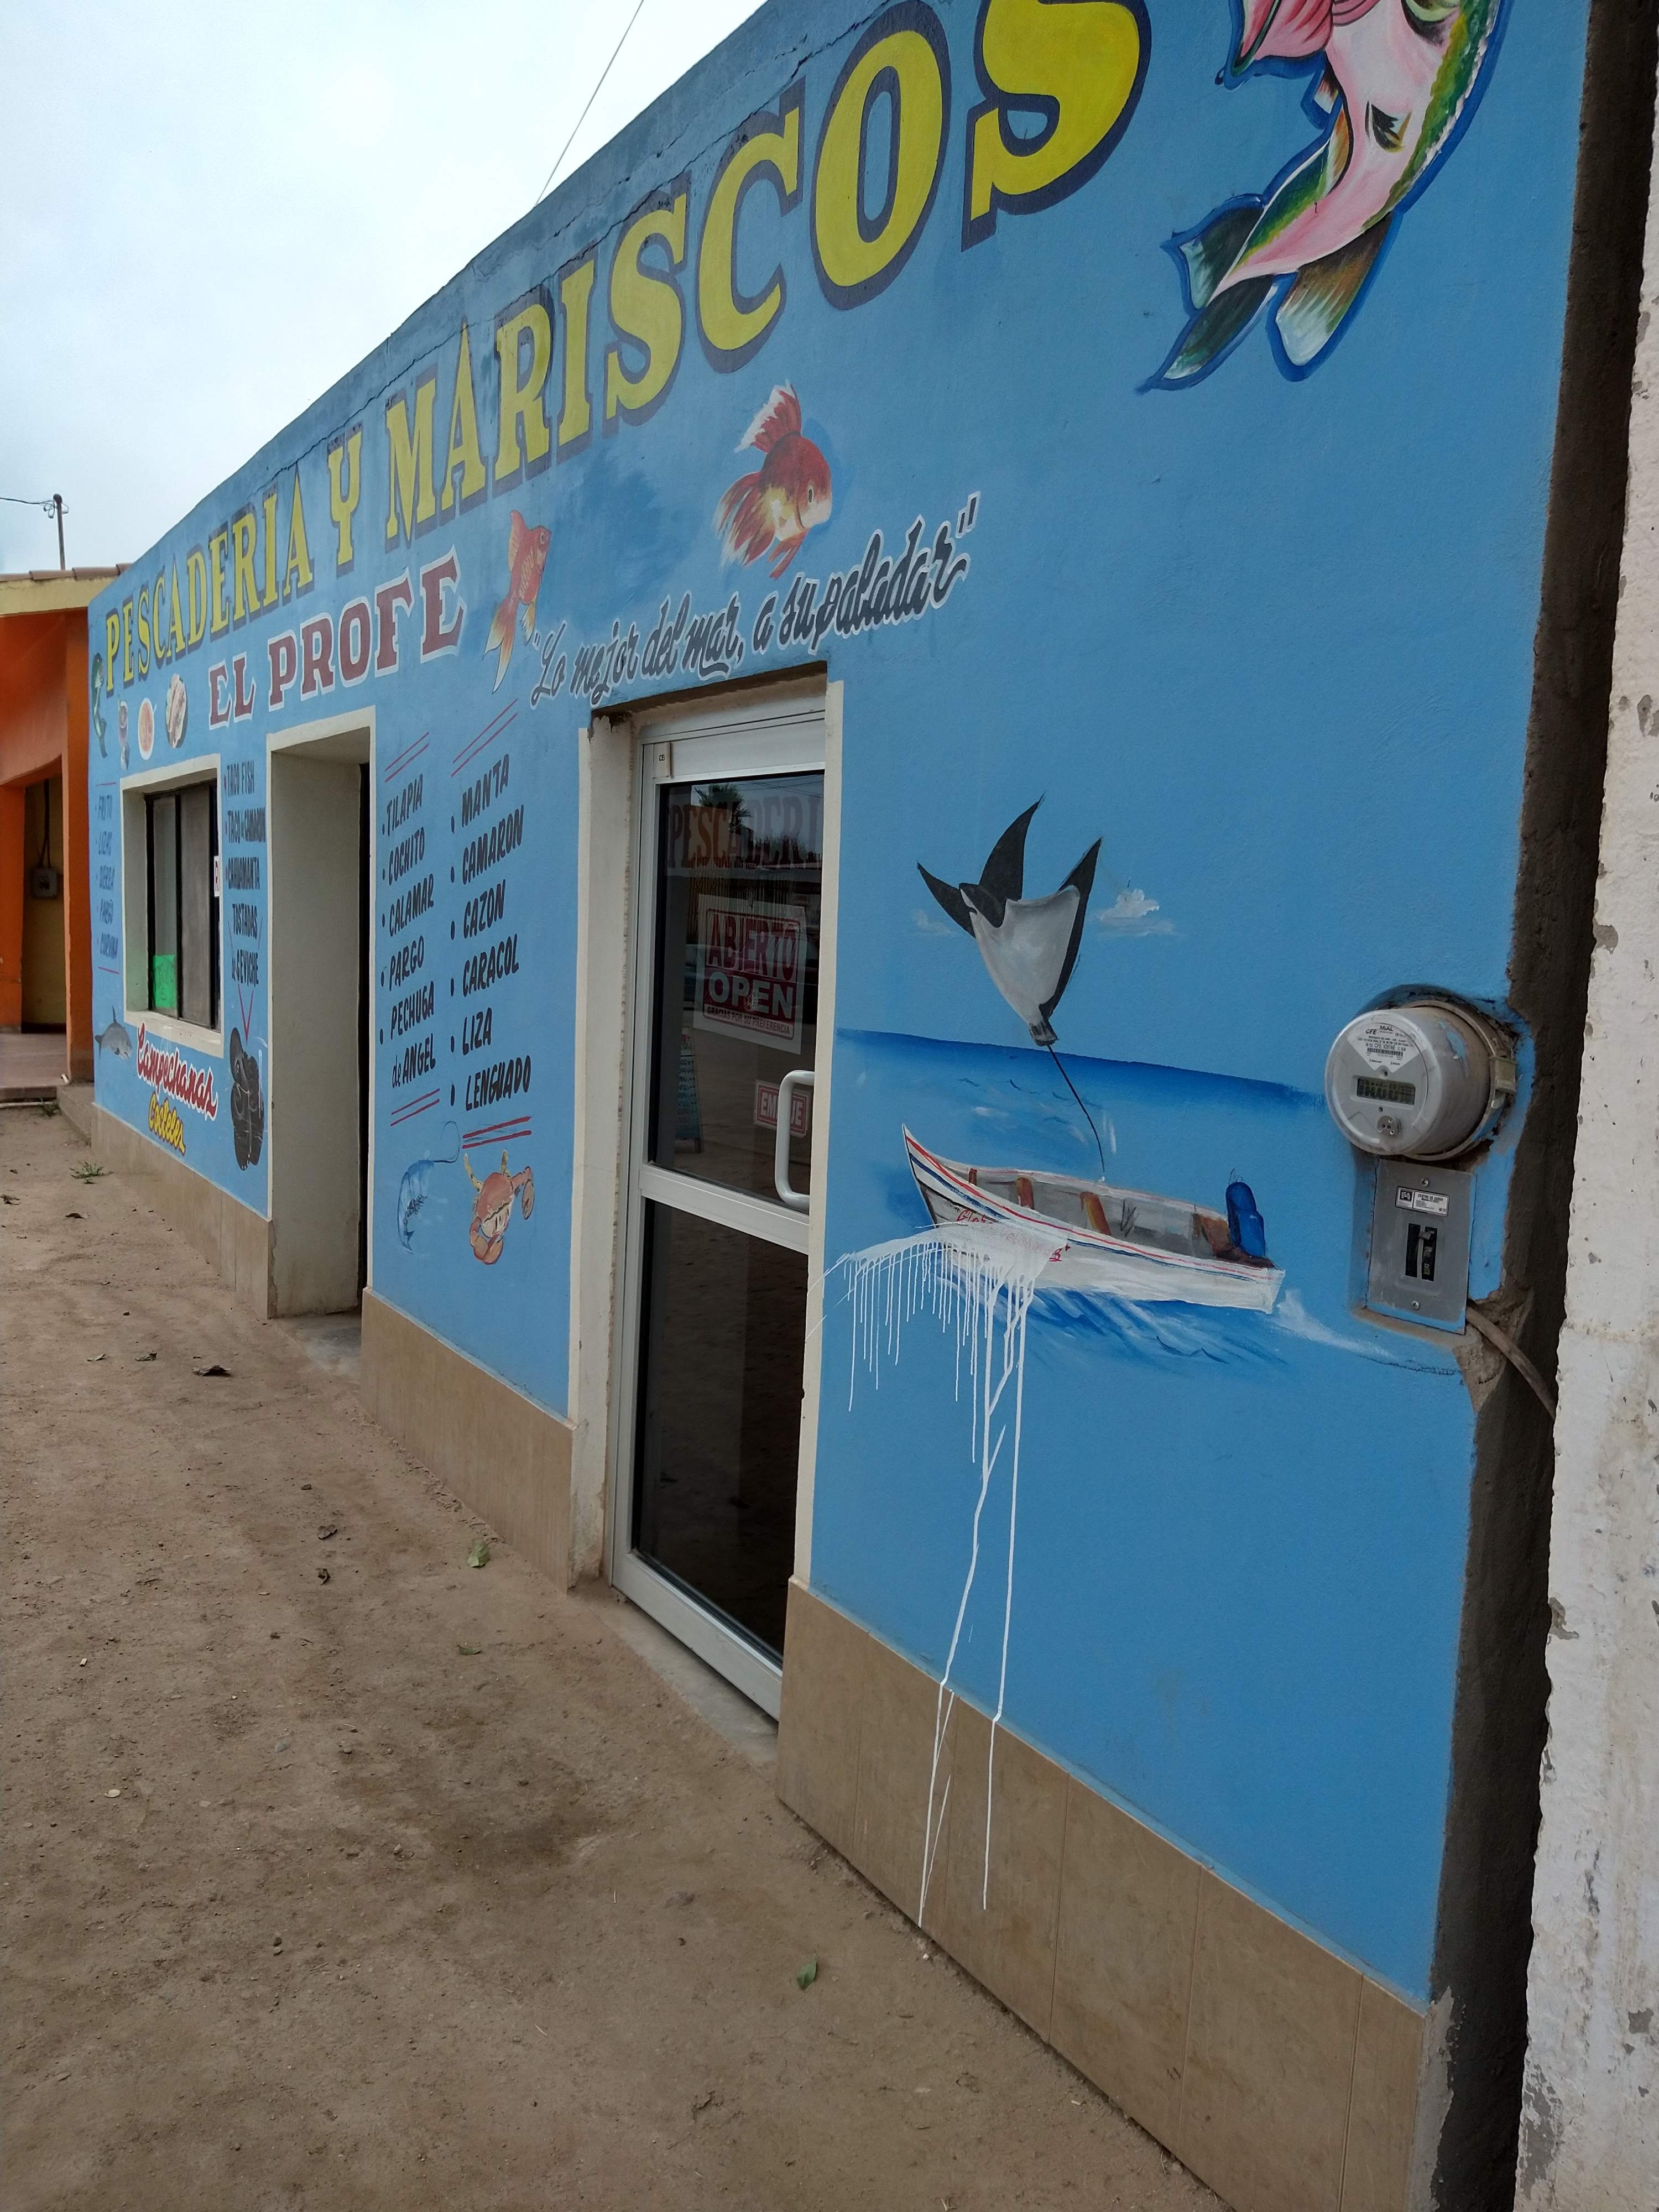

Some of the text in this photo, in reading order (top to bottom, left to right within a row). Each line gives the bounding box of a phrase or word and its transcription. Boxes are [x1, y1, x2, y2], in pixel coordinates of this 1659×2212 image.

[105, 0, 1151, 698] PESCADERIA Y MARISCOS
[208, 544, 467, 730] EL PROFE
[573, 618, 639, 708] mejor
[641, 591, 691, 681] del
[753, 591, 778, 655] a
[779, 572, 821, 651] su
[227, 760, 254, 796] TACO FISH
[387, 773, 424, 837] TILAPIA
[462, 754, 509, 828] MANTA
[227, 810, 241, 844] TACO
[388, 826, 425, 886] COCHITO
[462, 804, 525, 885] CAMARON
[666, 795, 822, 869] PESCADERI
[232, 903, 258, 940] TOSTADAS
[389, 873, 435, 937] CALAMAR
[463, 879, 506, 941] CAZON
[236, 949, 259, 987] CEVICHE
[389, 935, 425, 992] PARGO
[462, 933, 520, 997] CARACOL
[708, 914, 797, 982] ABIERTO
[390, 980, 435, 1042] PECHUGA
[707, 1006, 790, 1035] GRACIAS POR SU PREFERENCIA
[708, 972, 794, 1019] OPEN
[462, 1007, 492, 1056] LIZA
[137, 1022, 218, 1121] Campechanas
[392, 1044, 437, 1089] de ANGEL
[465, 1054, 532, 1112] LENGUADO
[148, 1091, 186, 1156] Cocteles
